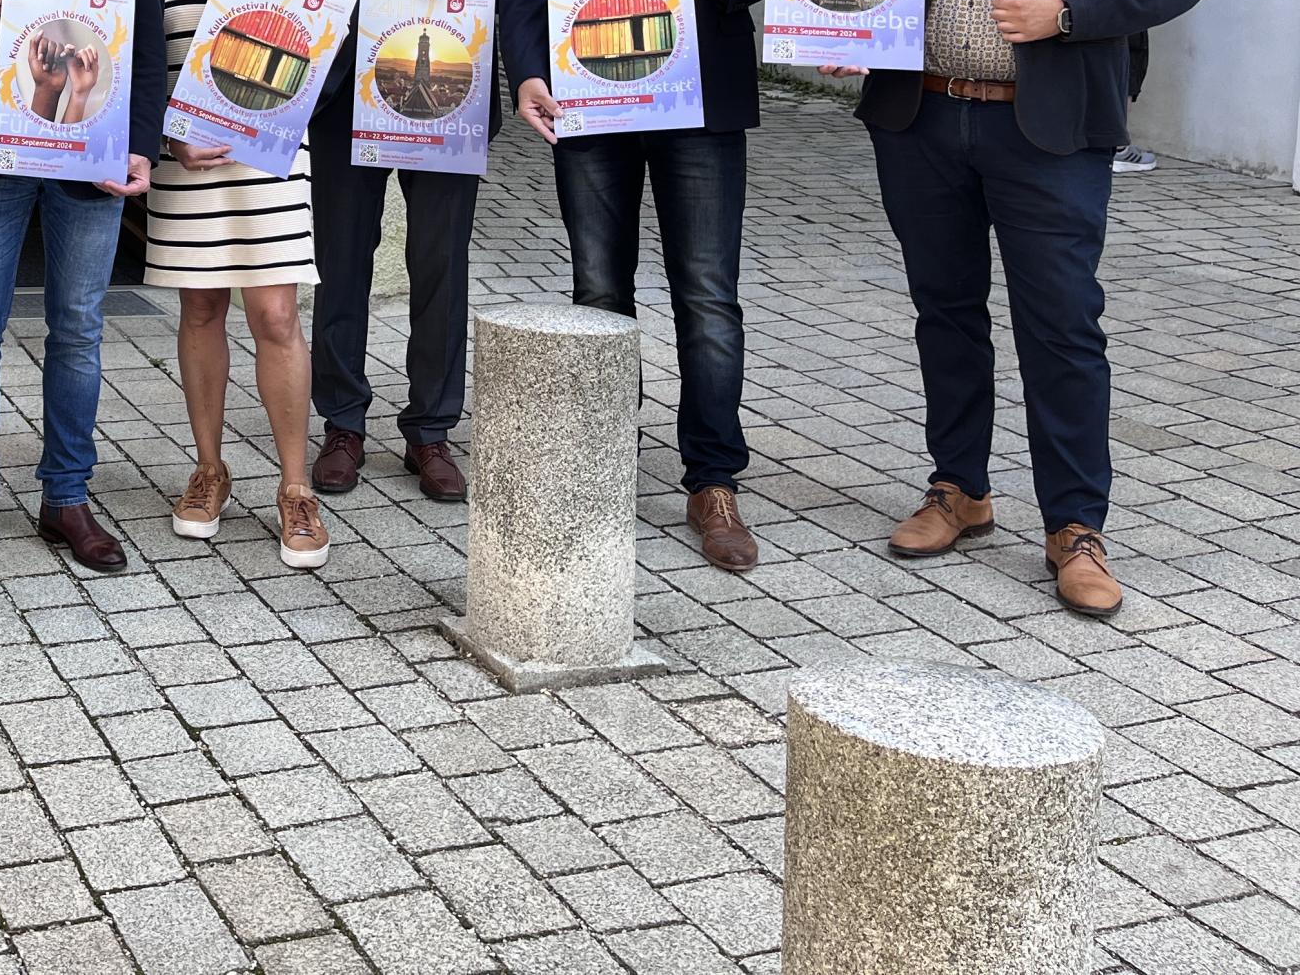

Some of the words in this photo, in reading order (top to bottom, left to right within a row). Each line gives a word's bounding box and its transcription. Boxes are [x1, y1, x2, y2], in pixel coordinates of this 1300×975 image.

[208, 2, 268, 36] Kulturfestival
[271, 4, 312, 43] Nördlingen
[800, 28, 838, 37] September
[8, 9, 60, 59] Kulturfestival
[62, 10, 108, 41] Nördlingen
[367, 17, 415, 63] Kulturfestival
[418, 17, 466, 43] Nördlingen
[558, 78, 695, 98] Denkerwerkstatt
[586, 98, 622, 107] September
[175, 102, 185, 110] 21.
[189, 106, 198, 116] 22.
[199, 110, 229, 127] September
[231, 121, 246, 133] 2024
[21, 139, 56, 148] September
[382, 134, 415, 142] September
